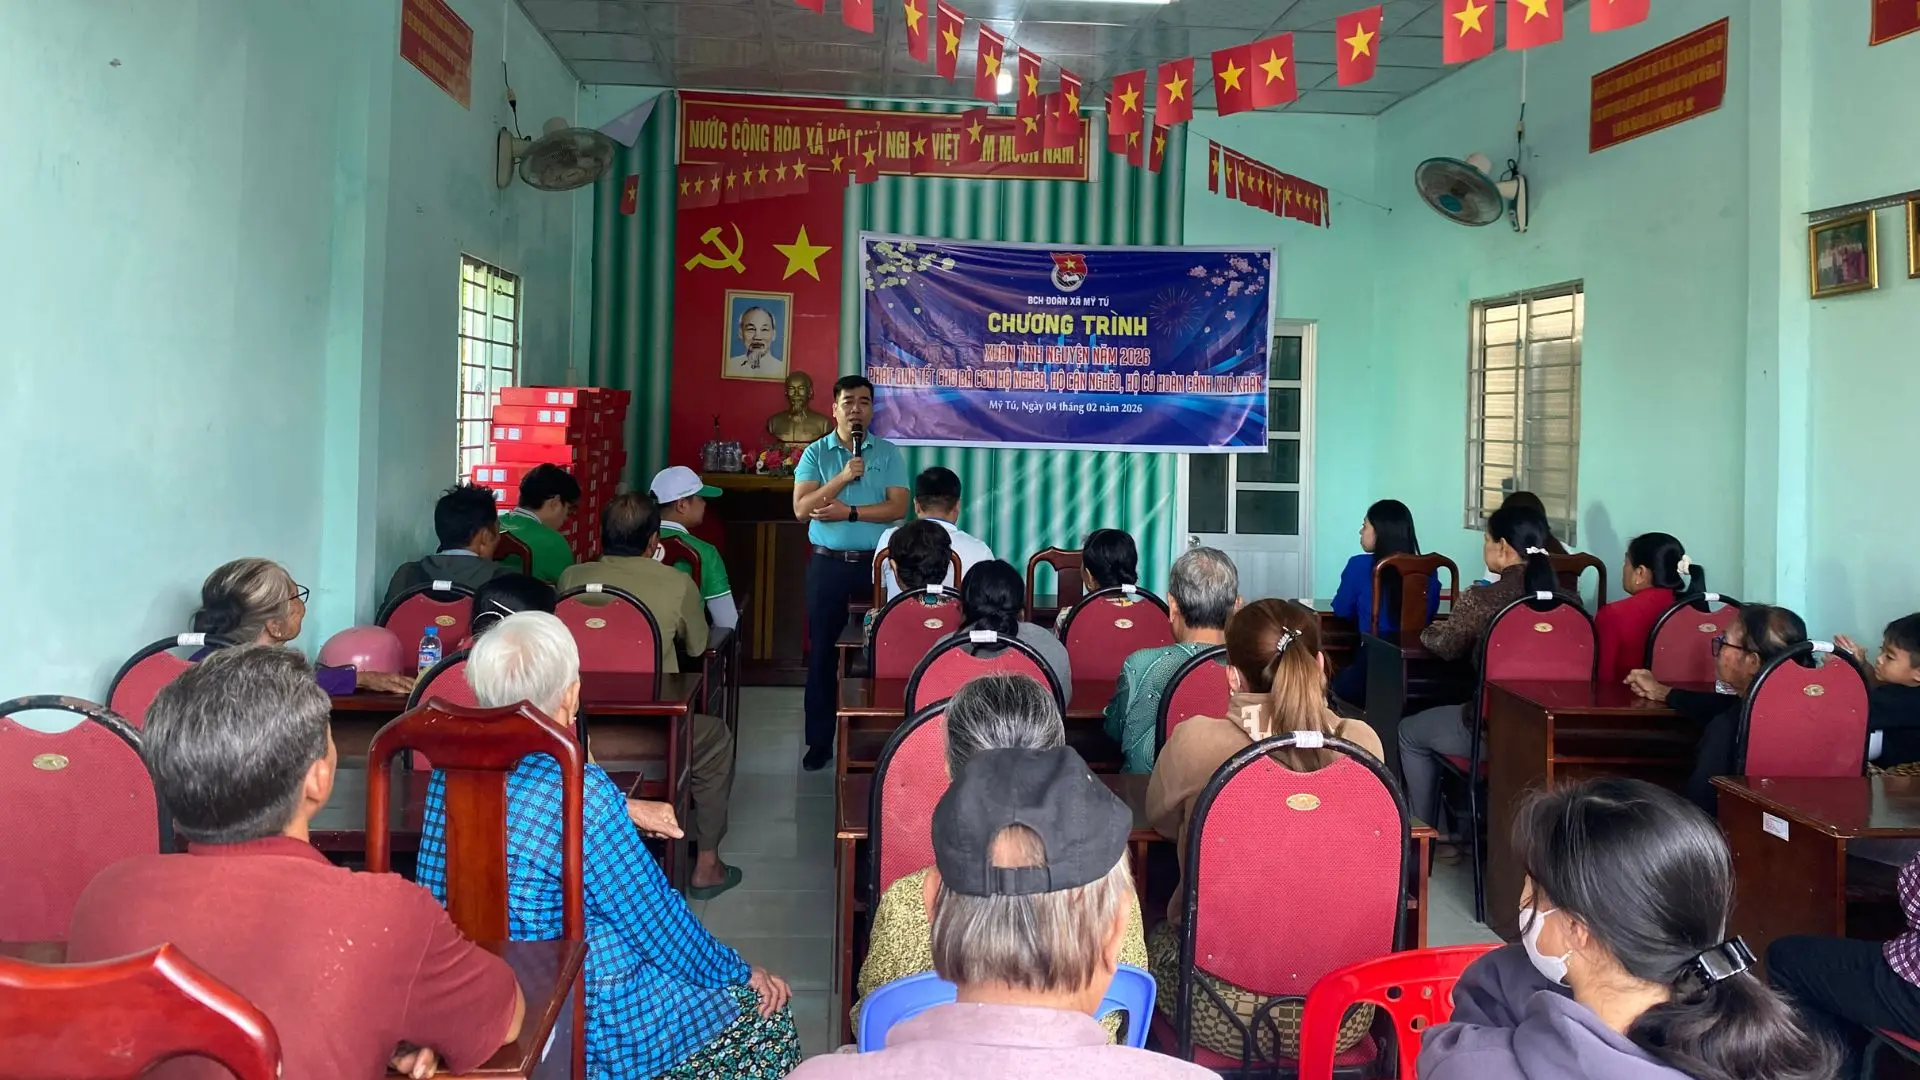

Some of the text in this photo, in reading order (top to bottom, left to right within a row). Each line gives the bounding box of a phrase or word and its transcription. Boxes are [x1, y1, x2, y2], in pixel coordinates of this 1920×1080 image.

[688, 116, 728, 150] NƯỚC
[731, 117, 770, 158] CỘNG
[773, 118, 801, 153] HÒA
[931, 127, 961, 167] VIỆT
[1027, 294, 1110, 307] BCH ĐOÀN XÃ MỸ TÚ
[987, 310, 1148, 336] CHƯƠNG TRÌNH
[984, 341, 1151, 368] XUÂN TÌNH NGUYỆN NĂM 2026
[867, 363, 1264, 395] PHÁT QUÀ TẾT CHO BÀ CON HỘ NGHÈO, HỘ CẬN NGHÈO, HỘ CÓ HOÀN CẢNH KHÓ KHĂN
[989, 400, 1143, 415] Mỹ Tú, Ngày 04 tháng 02 năm 2026
